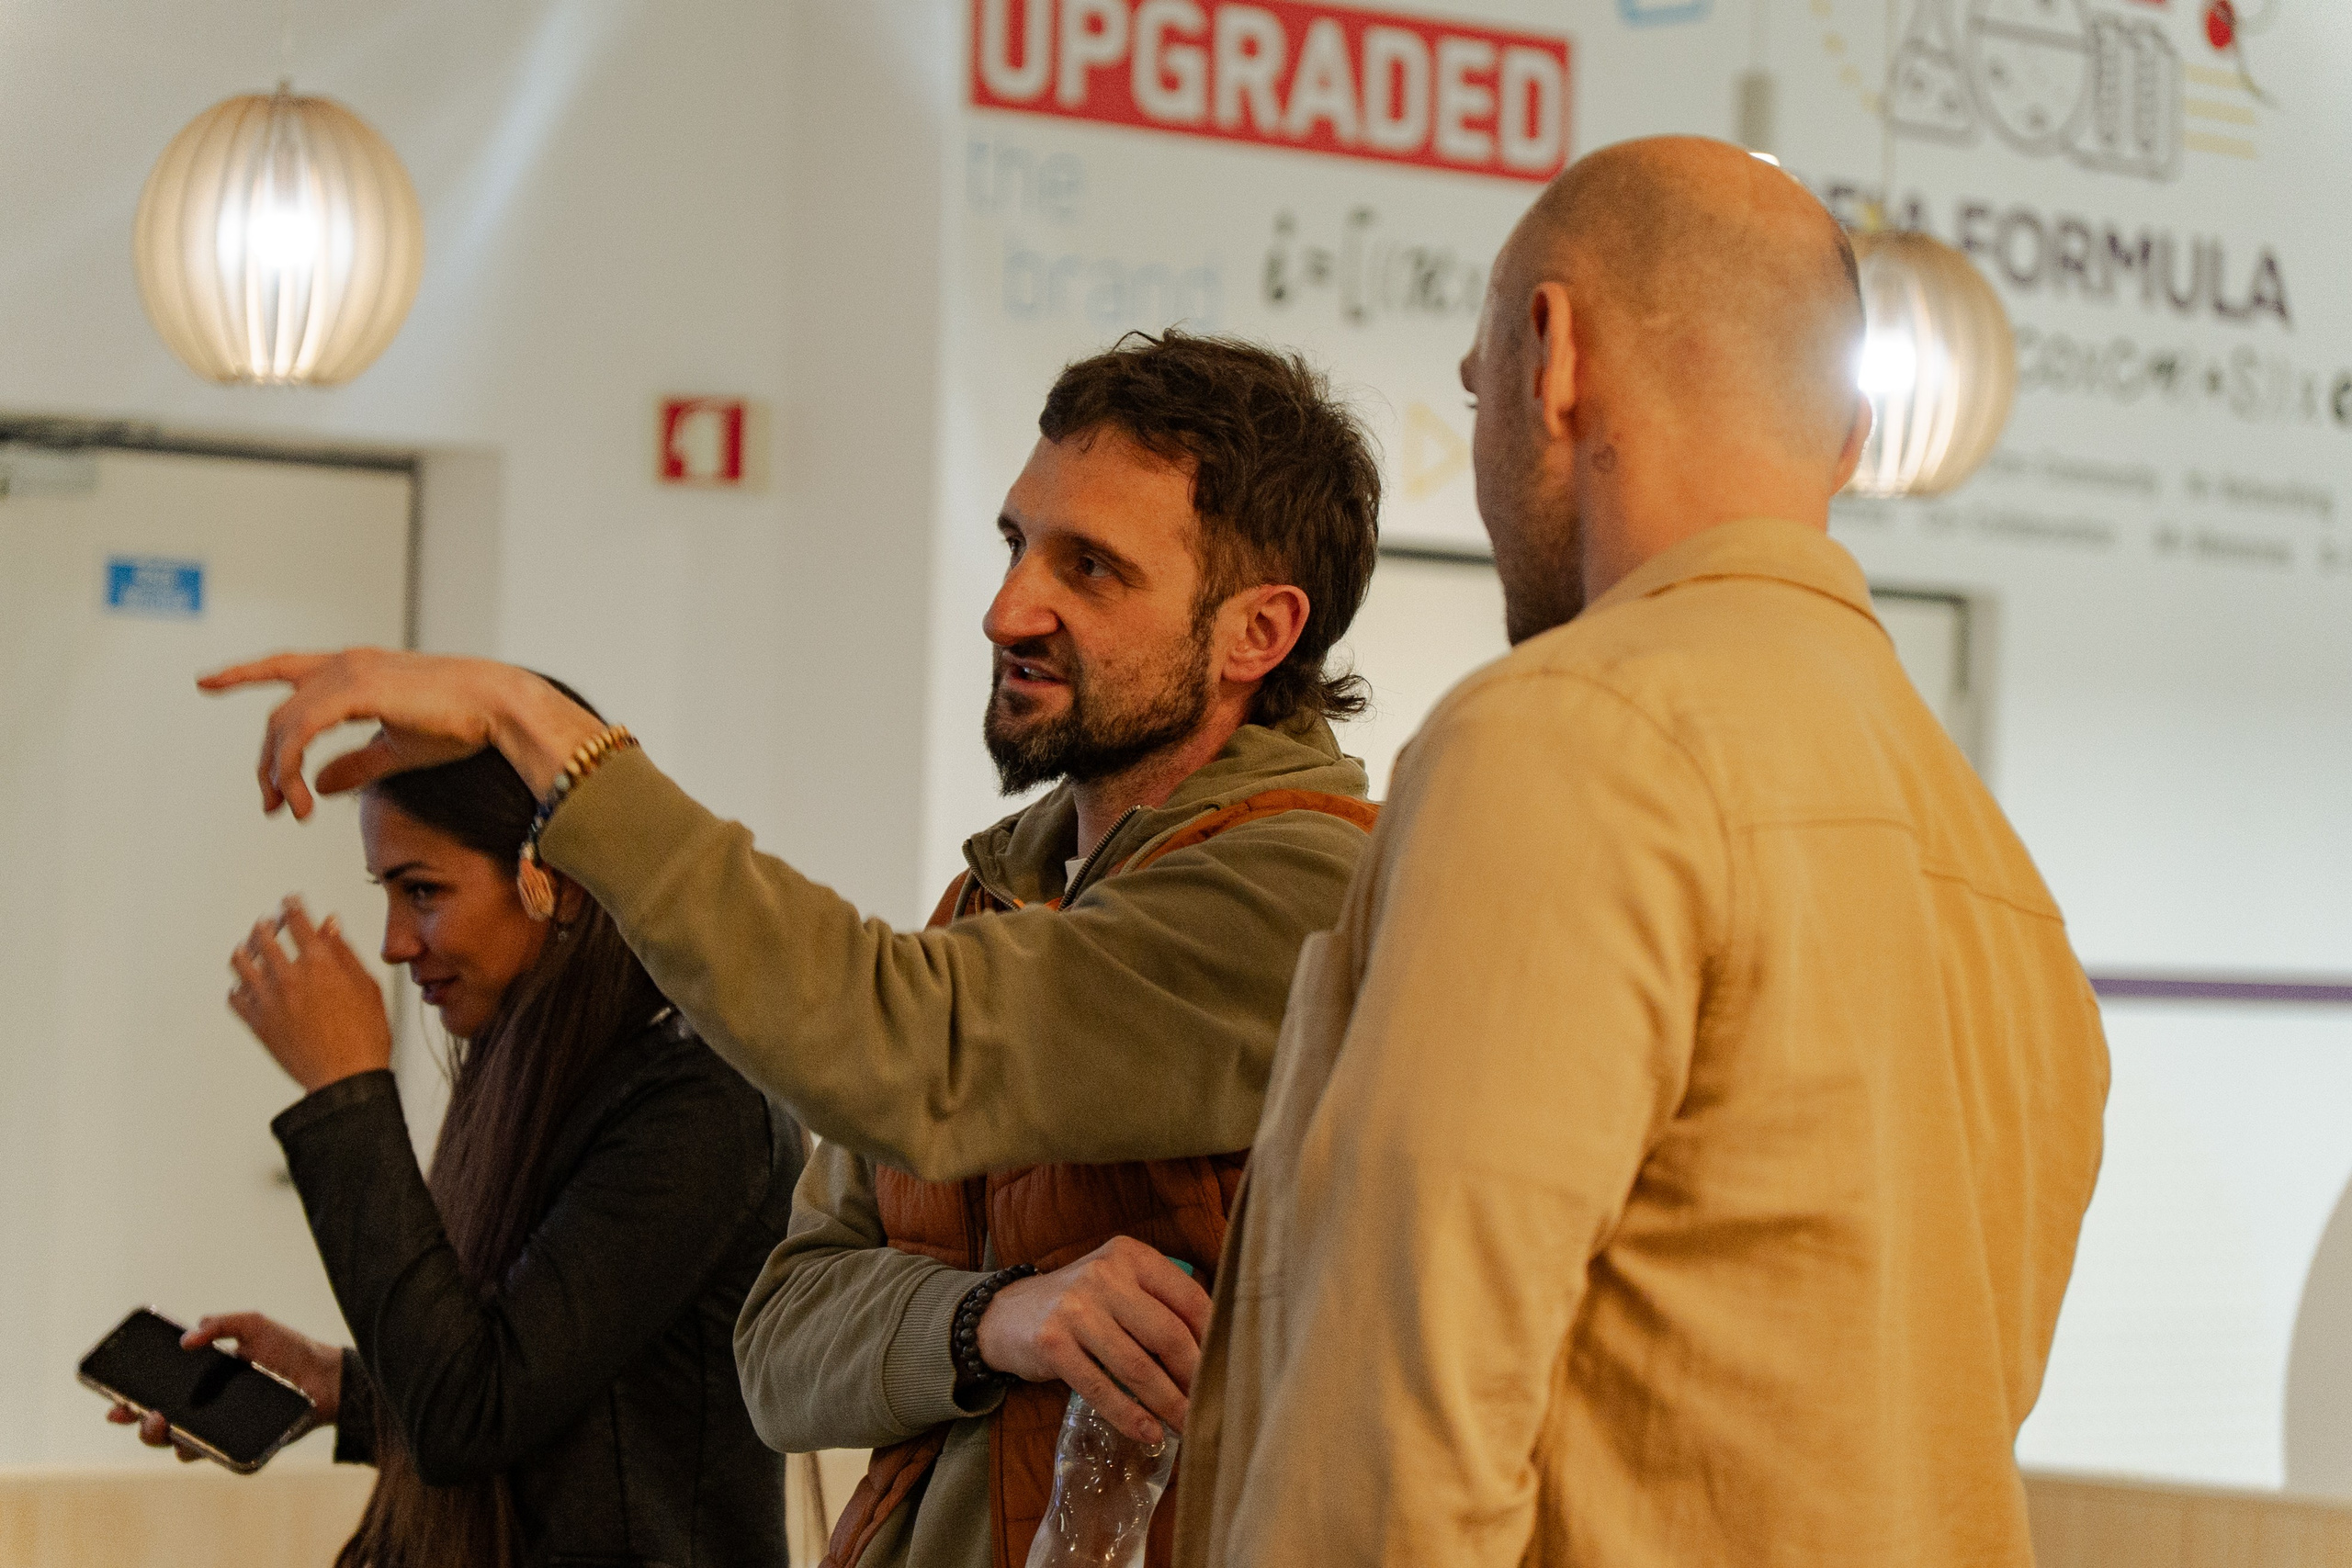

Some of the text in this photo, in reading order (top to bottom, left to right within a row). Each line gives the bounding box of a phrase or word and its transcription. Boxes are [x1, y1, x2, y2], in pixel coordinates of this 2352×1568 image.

[978, 0, 1567, 170] UPGRADED
[965, 139, 1084, 222] the
[1957, 200, 2293, 325] FORMULA
